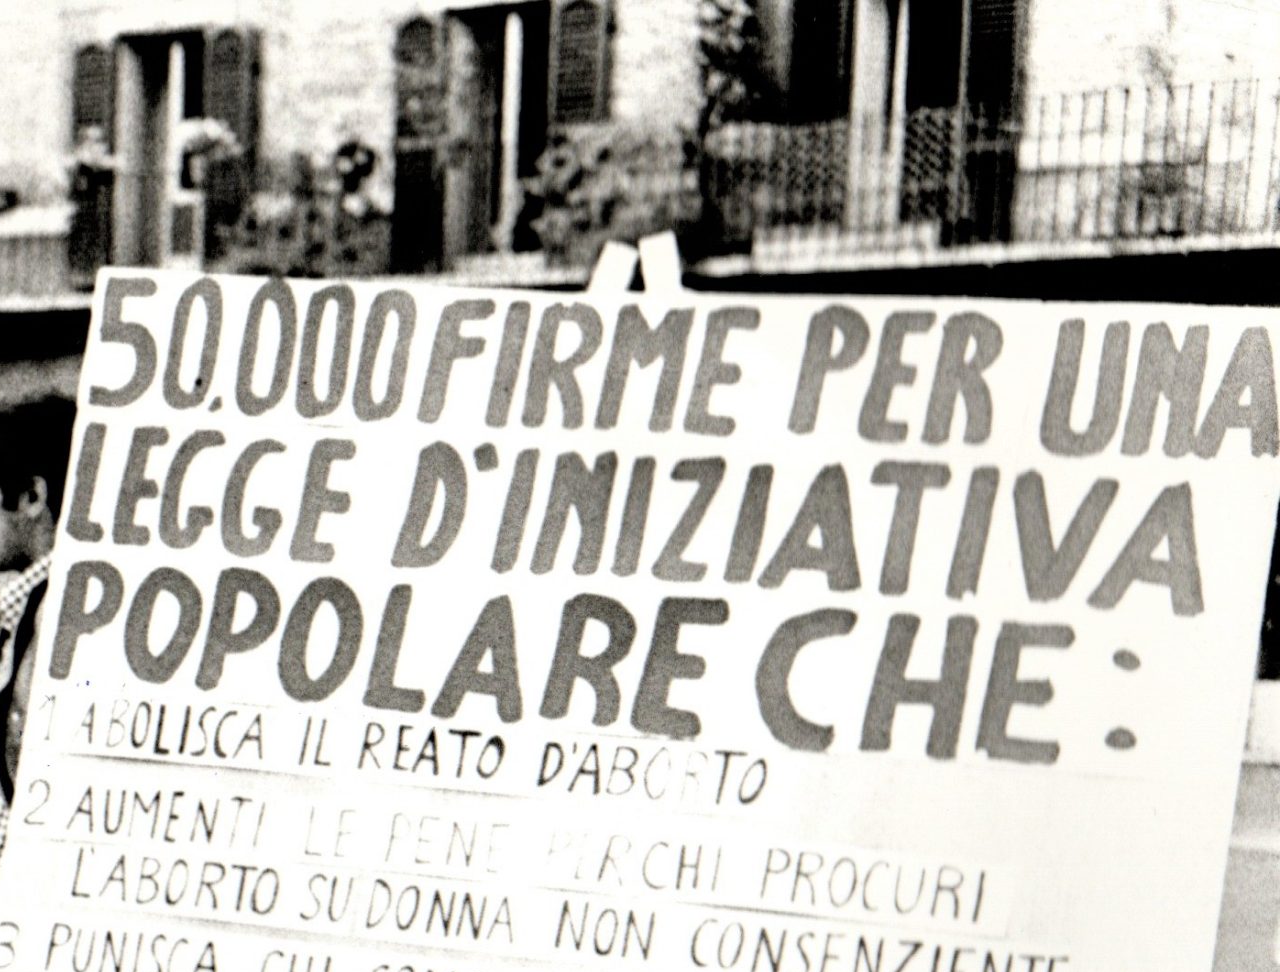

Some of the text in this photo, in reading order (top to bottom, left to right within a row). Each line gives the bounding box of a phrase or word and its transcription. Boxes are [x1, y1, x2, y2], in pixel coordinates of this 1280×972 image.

[417, 298, 762, 437] FIRME
[787, 303, 1004, 445] PER
[1039, 317, 1280, 459] UNA
[65, 422, 1205, 617] LEGGE D'INIZIATIVA
[48, 560, 730, 741] POPOLARE
[39, 694, 768, 805] 1 ABOLISCA IL REATO D'ABORTO
[23, 778, 51, 827] 2
[66, 785, 266, 849] AUMENTI
[303, 805, 357, 859] LE
[385, 812, 510, 874] PENE
[761, 847, 986, 924] PROCURI
[71, 847, 280, 915] L'ABORTO
[365, 878, 514, 944] DONNA
[554, 900, 656, 961] NON
